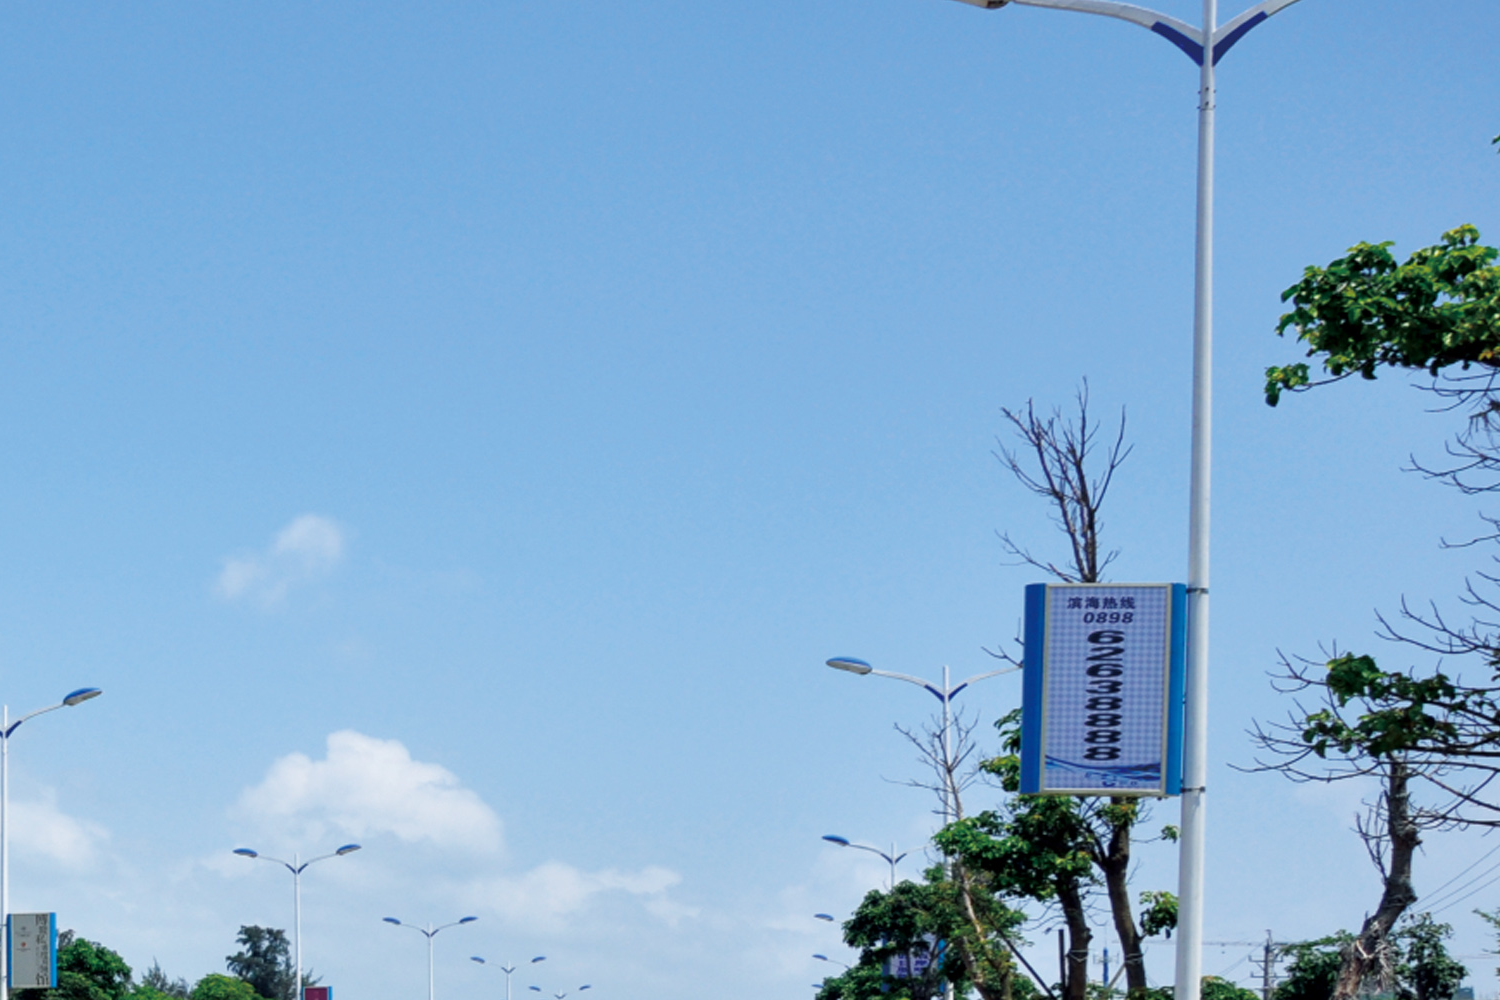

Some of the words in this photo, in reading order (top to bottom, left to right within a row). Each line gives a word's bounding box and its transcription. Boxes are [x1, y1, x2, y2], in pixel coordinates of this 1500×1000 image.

[1067, 596, 1136, 609] 滨海热线
[1083, 612, 1134, 624] 0898
[1083, 630, 1125, 761] 62638888
